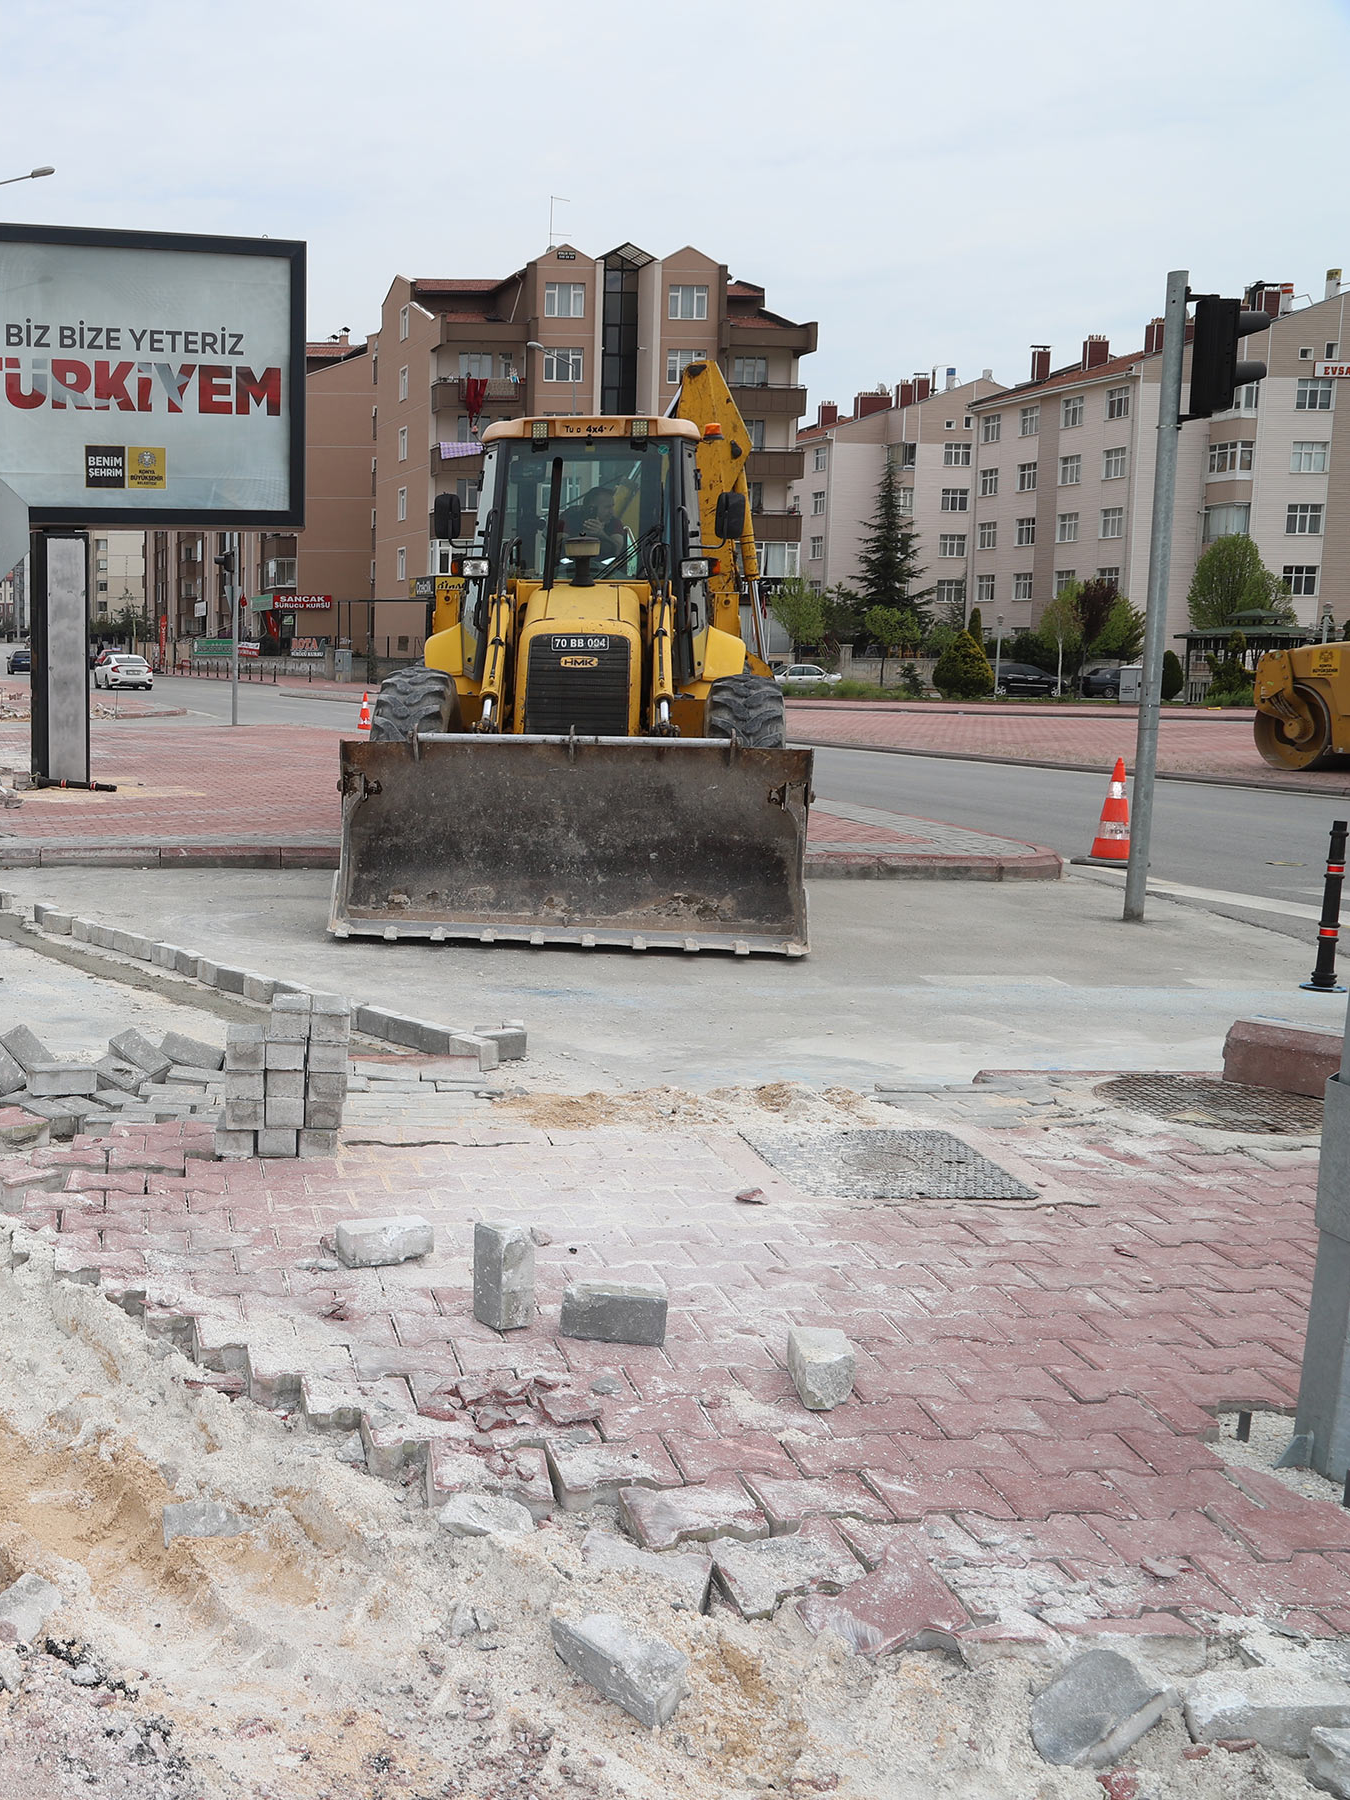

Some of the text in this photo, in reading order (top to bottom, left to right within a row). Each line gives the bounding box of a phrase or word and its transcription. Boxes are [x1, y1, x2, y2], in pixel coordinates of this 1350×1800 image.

[6, 318, 244, 355] BİZ BİZE YETERİZ
[88, 456, 122, 466] BENİM
[88, 468, 122, 478] ŞEHRİM
[291, 638, 318, 650] ROTA
[555, 639, 567, 647] 70
[570, 639, 584, 647] BB
[564, 658, 594, 666] HMK
